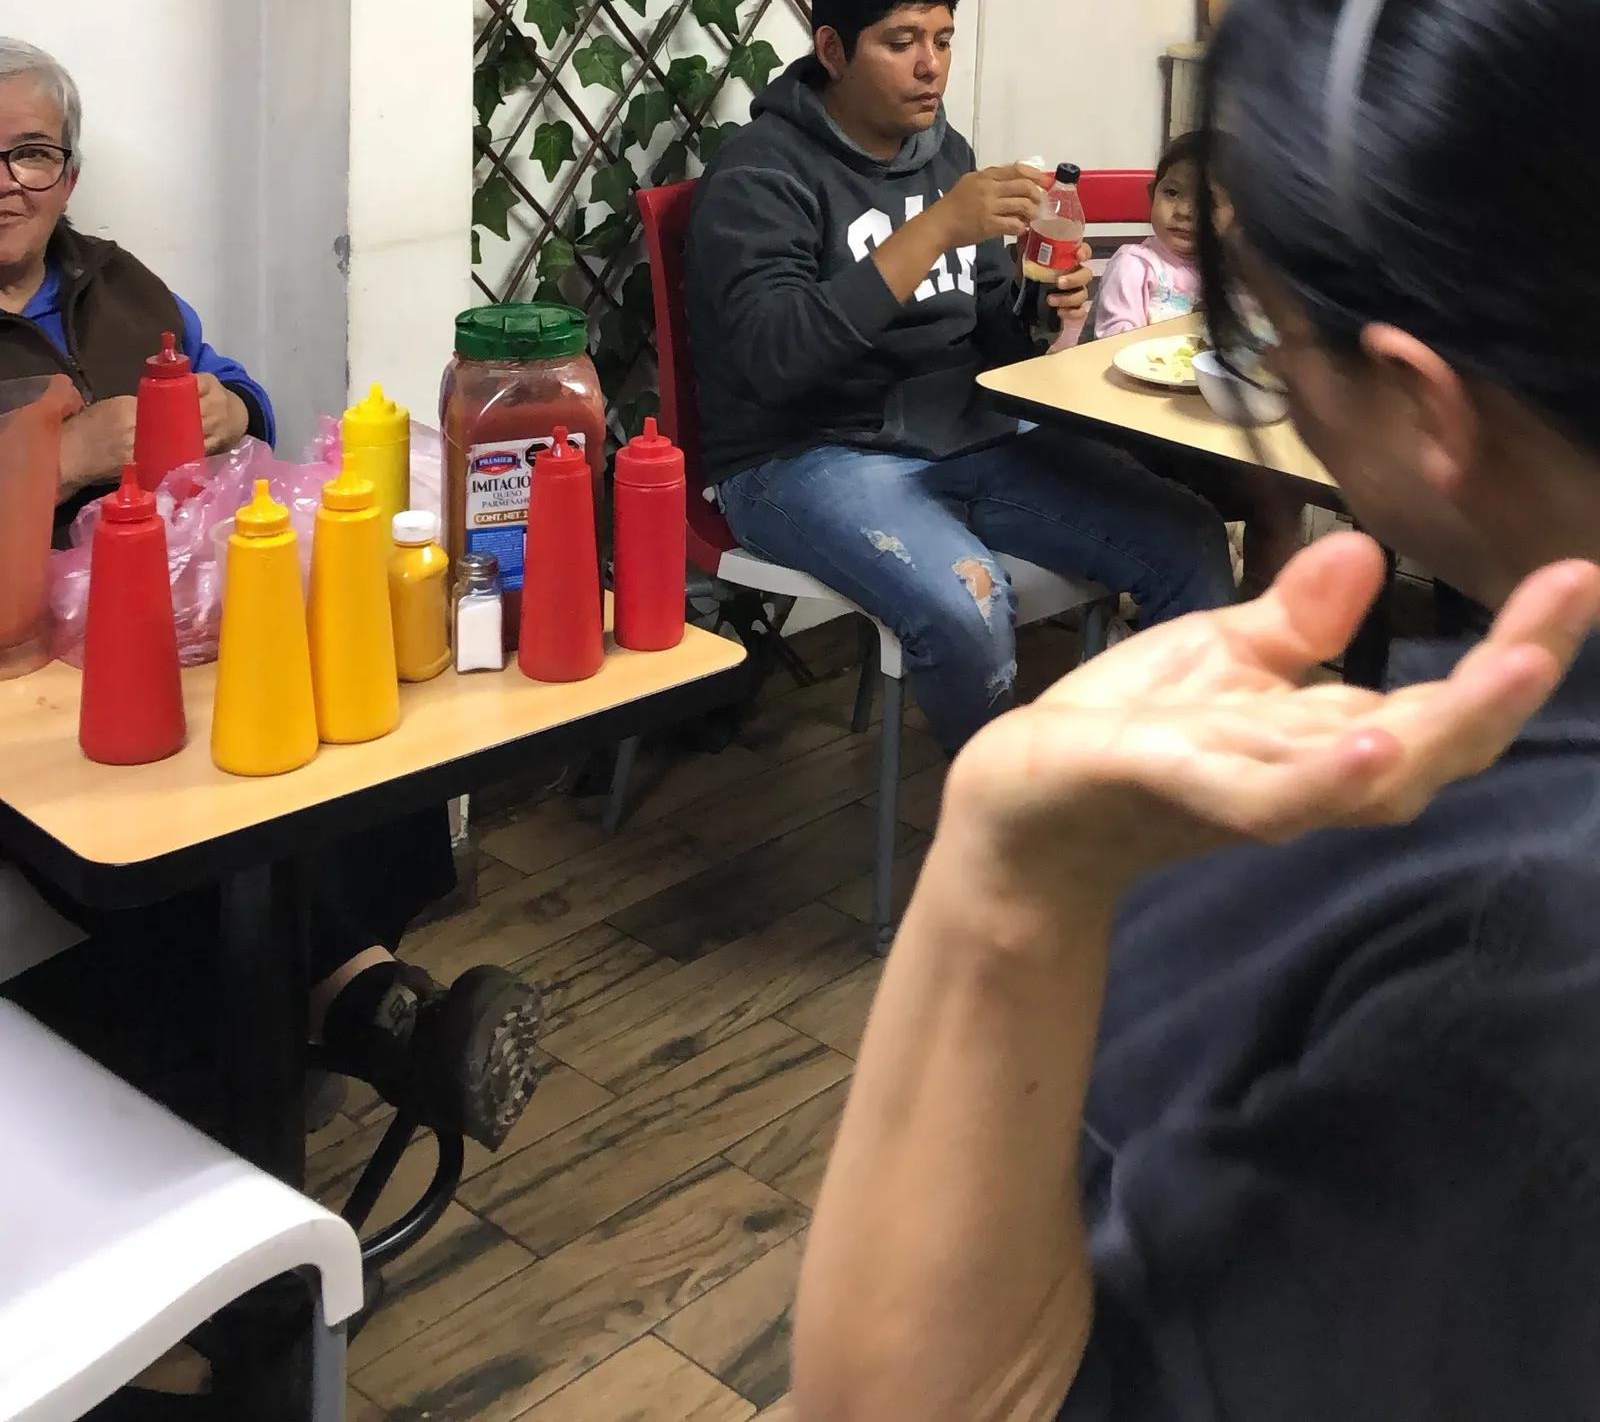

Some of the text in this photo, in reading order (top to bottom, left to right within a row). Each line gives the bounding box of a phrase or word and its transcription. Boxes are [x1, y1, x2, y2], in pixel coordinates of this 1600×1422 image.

[479, 456, 513, 466] PREMIER
[493, 490, 522, 500] QUESO
[475, 513, 503, 523] CONT.
